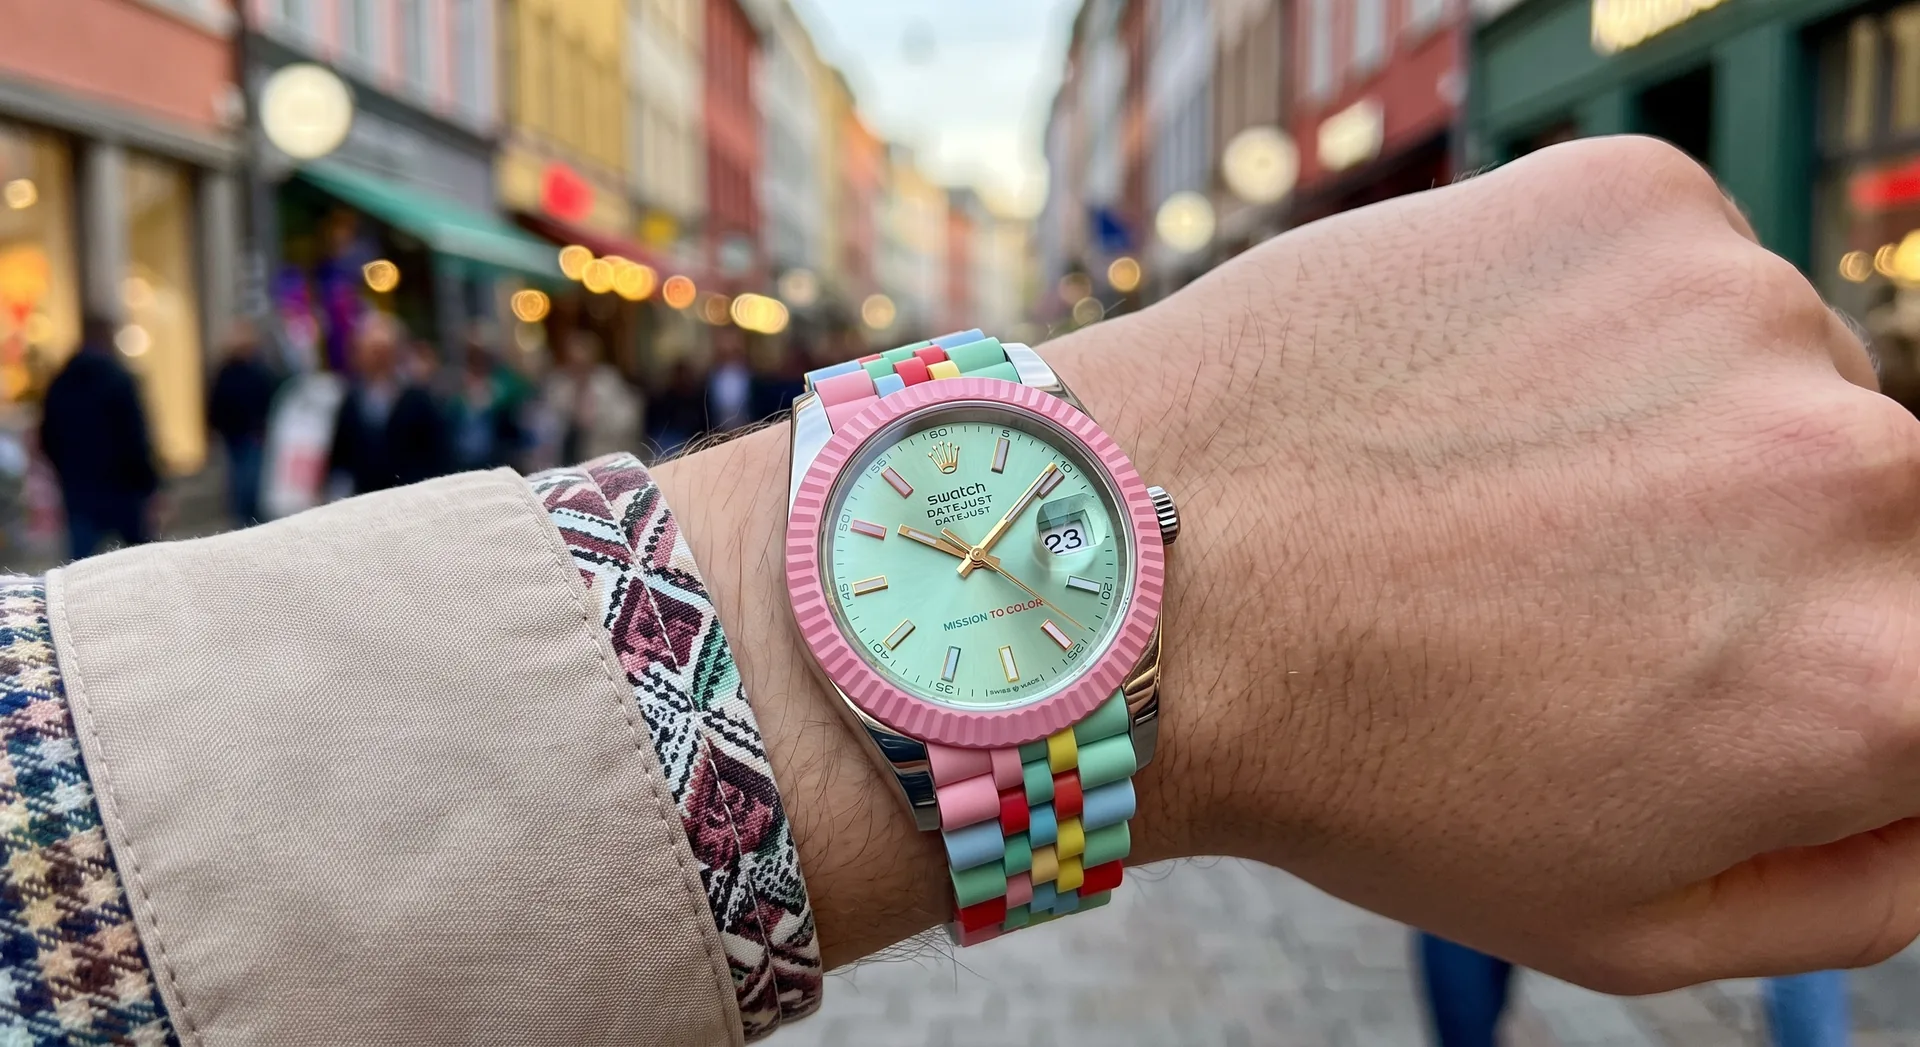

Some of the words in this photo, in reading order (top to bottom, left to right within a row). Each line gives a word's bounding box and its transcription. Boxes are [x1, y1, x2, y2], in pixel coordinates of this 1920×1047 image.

[929, 428, 948, 439] 60
[1001, 429, 1011, 438] 5
[870, 459, 887, 474] 55
[1060, 460, 1073, 473] 10
[927, 482, 986, 506] swatch
[926, 494, 993, 518] DATEJUST
[838, 513, 850, 532] 50
[935, 506, 991, 526] DATEJUST
[1044, 529, 1082, 554] 23
[839, 583, 851, 601] 45
[1101, 582, 1113, 600] 20
[943, 612, 988, 632] MISSION
[989, 608, 1005, 619] TO
[1006, 598, 1044, 615] COLOR
[872, 643, 890, 660] 40
[1067, 643, 1084, 660] 25
[935, 682, 954, 695] 35
